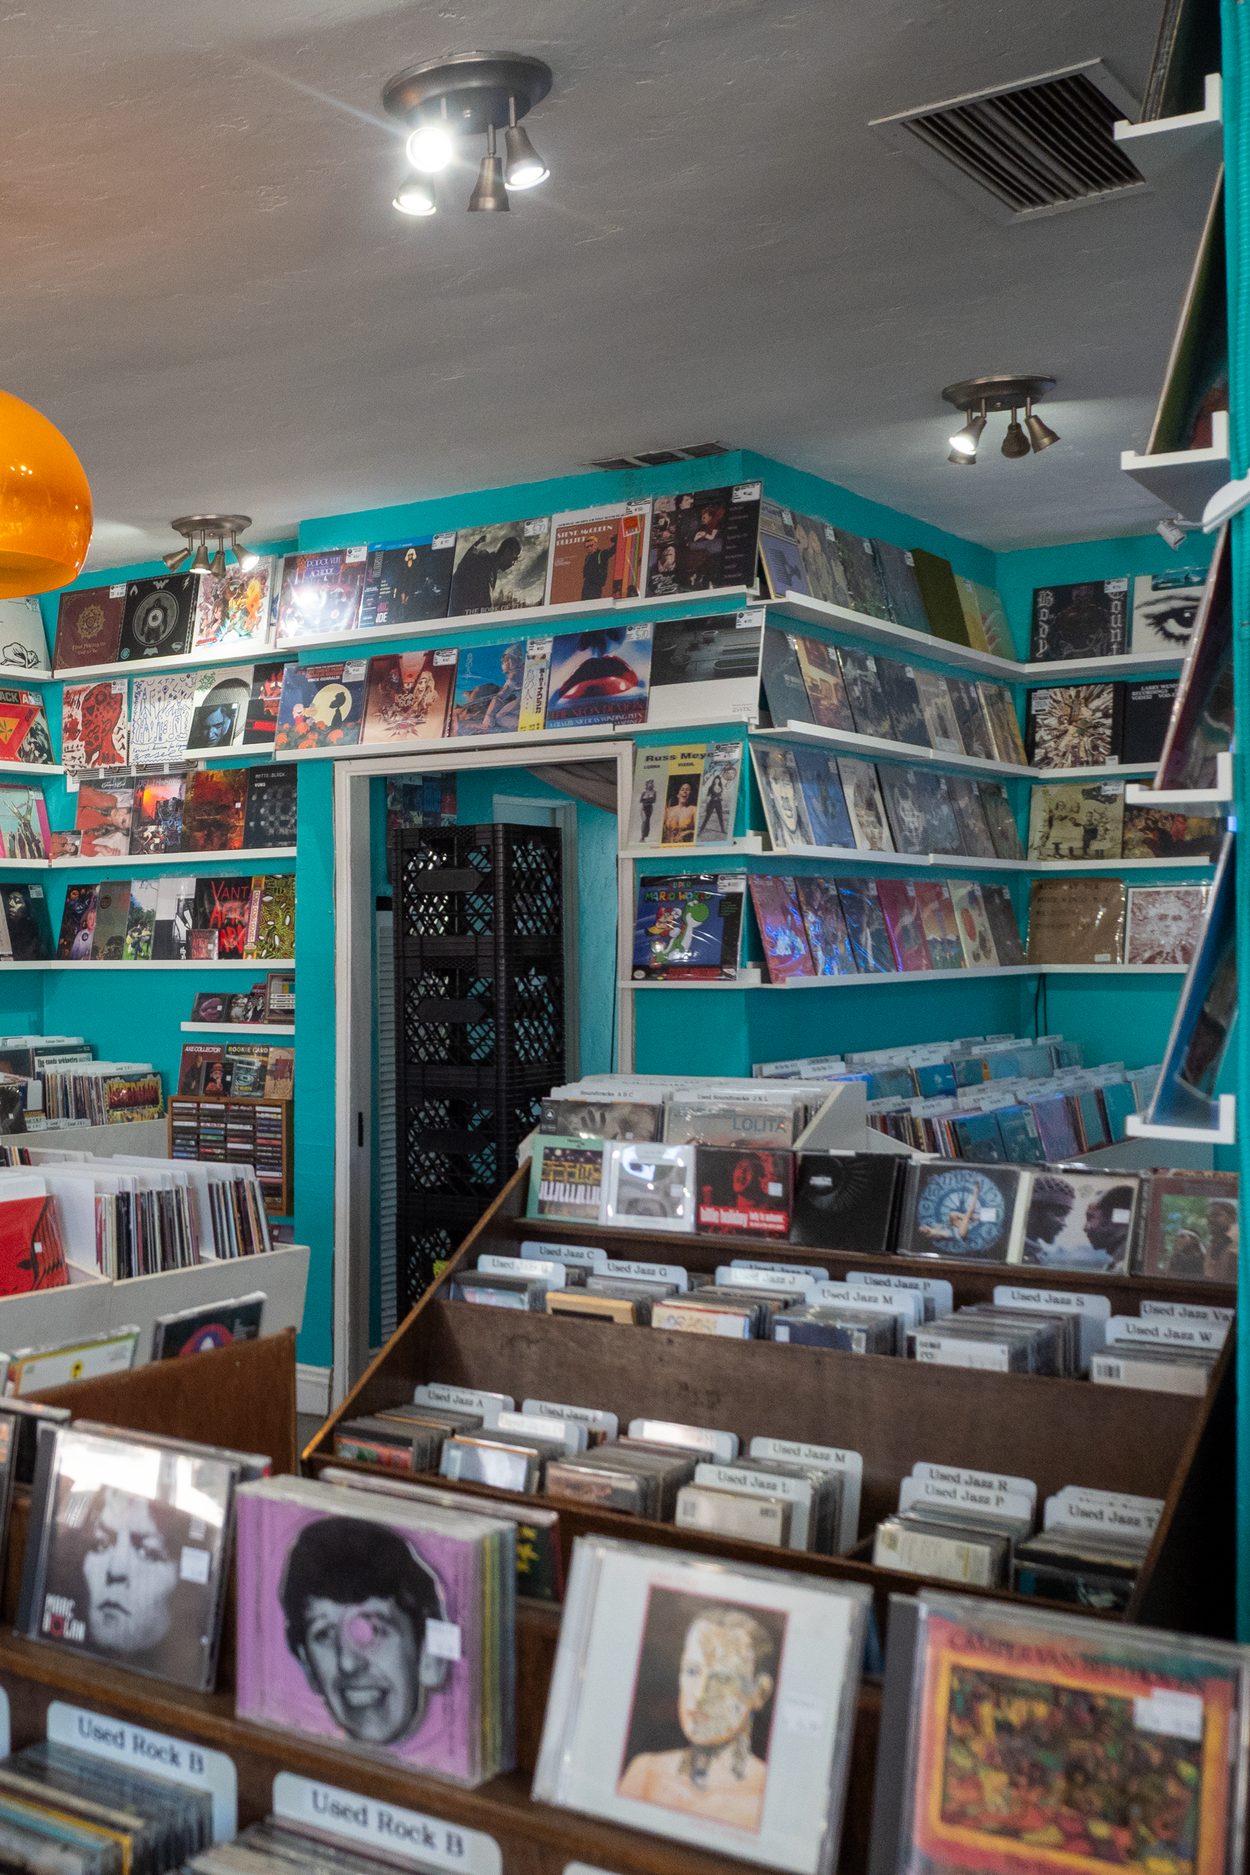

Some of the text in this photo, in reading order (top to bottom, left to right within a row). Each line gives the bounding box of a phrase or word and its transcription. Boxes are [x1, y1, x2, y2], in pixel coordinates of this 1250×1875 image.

[557, 530, 578, 540] STEVE
[481, 606, 499, 614] BOOK
[646, 754, 677, 762] Russ
[669, 880, 692, 889] SUPER
[645, 890, 712, 902] MARIO WORLD
[579, 1089, 615, 1097] Soundtracks
[733, 1112, 787, 1134] LOLITA
[699, 1205, 748, 1227] billie holiday
[539, 1245, 595, 1261] Used Jazz C
[491, 1258, 515, 1271] Used
[606, 1262, 631, 1276] Used
[631, 1265, 658, 1278] Jazz
[864, 1275, 921, 1291] Used Jazz
[821, 1288, 894, 1305] Used Jazz M
[1010, 1290, 1040, 1304] Used
[1042, 1294, 1072, 1307] Jazz
[1142, 1303, 1208, 1322] Used Jazz
[1125, 1324, 1213, 1343] Used Jazz W
[427, 1389, 450, 1403] Used
[452, 1394, 475, 1408] Jazz
[539, 1404, 561, 1417] Used
[772, 1441, 846, 1464] Used Jazz M
[716, 1469, 747, 1485] Used
[749, 1474, 779, 1491] Jazz
[929, 1467, 995, 1489] Used Jazz
[924, 1483, 991, 1506] Used Jazz
[1066, 1504, 1141, 1528] Used Jazz
[77, 1715, 206, 1776] Used Rock B
[311, 1789, 466, 1859] Used Rock B
